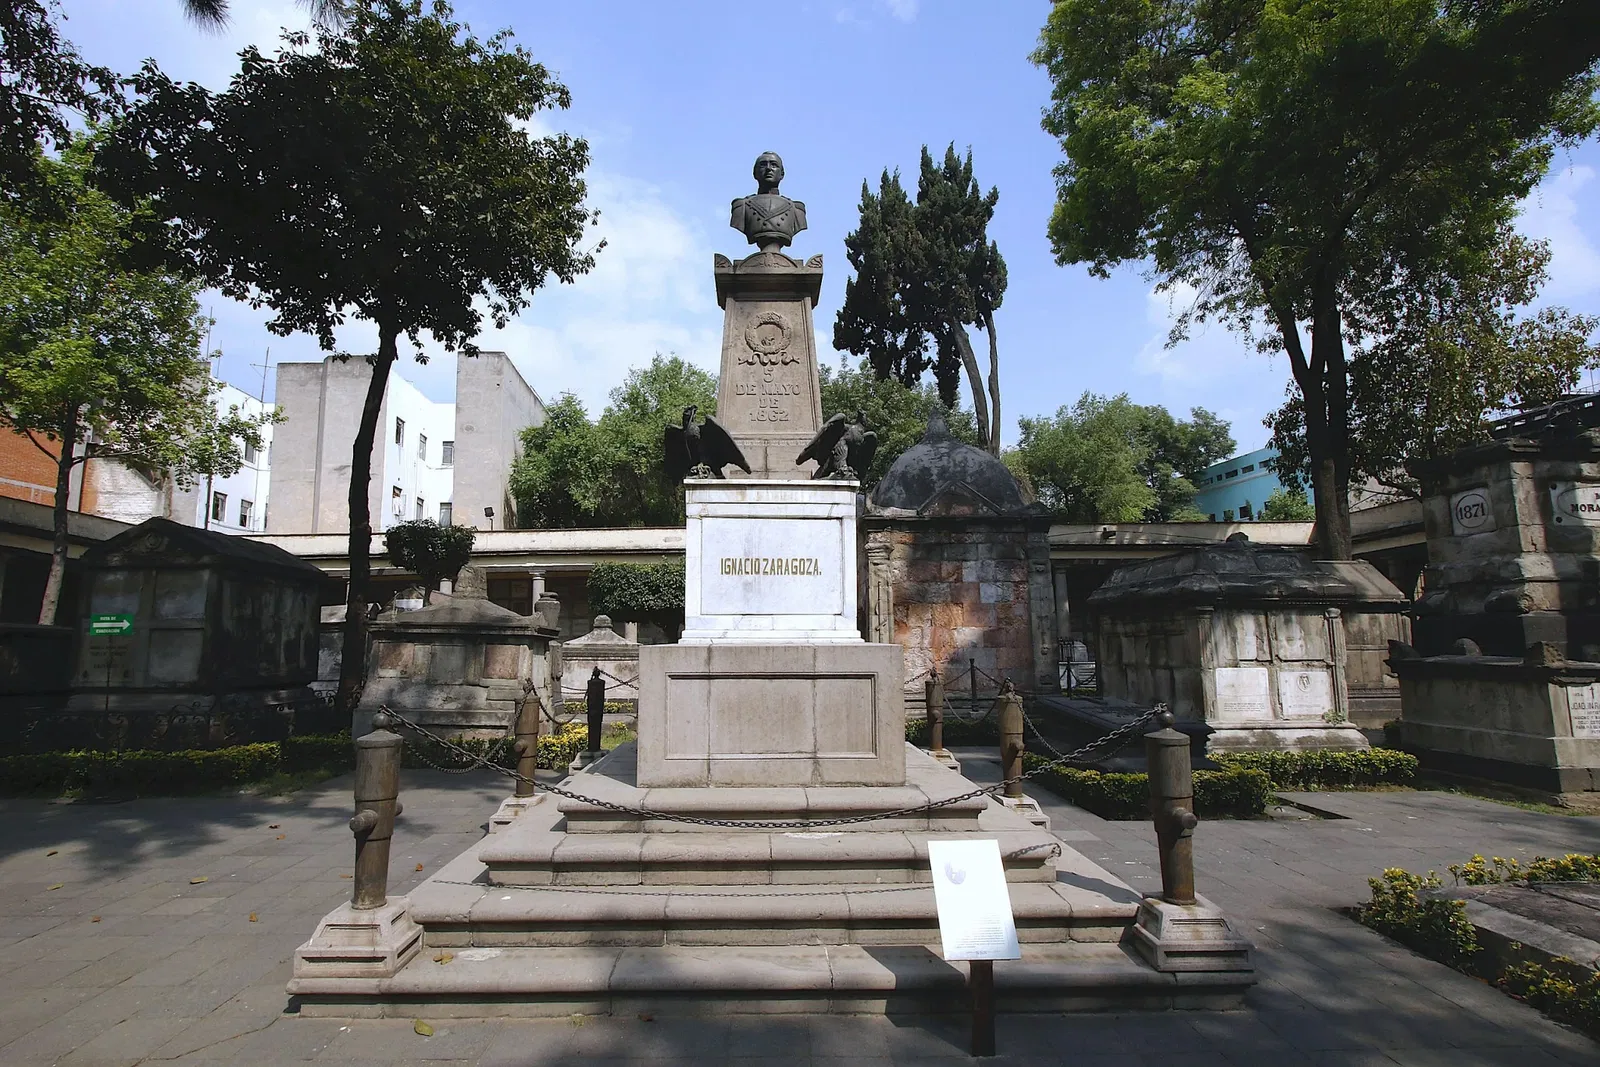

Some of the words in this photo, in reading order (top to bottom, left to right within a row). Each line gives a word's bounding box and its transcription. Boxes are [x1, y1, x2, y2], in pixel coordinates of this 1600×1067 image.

[763, 367, 774, 383] 5
[736, 384, 756, 395] DE
[762, 384, 800, 395] MAYO
[759, 398, 779, 408] DE
[749, 410, 788, 422] 1862
[1459, 502, 1486, 520] 1871
[720, 558, 760, 576] IGNACIO
[762, 558, 822, 576] ZARAGOZA.
